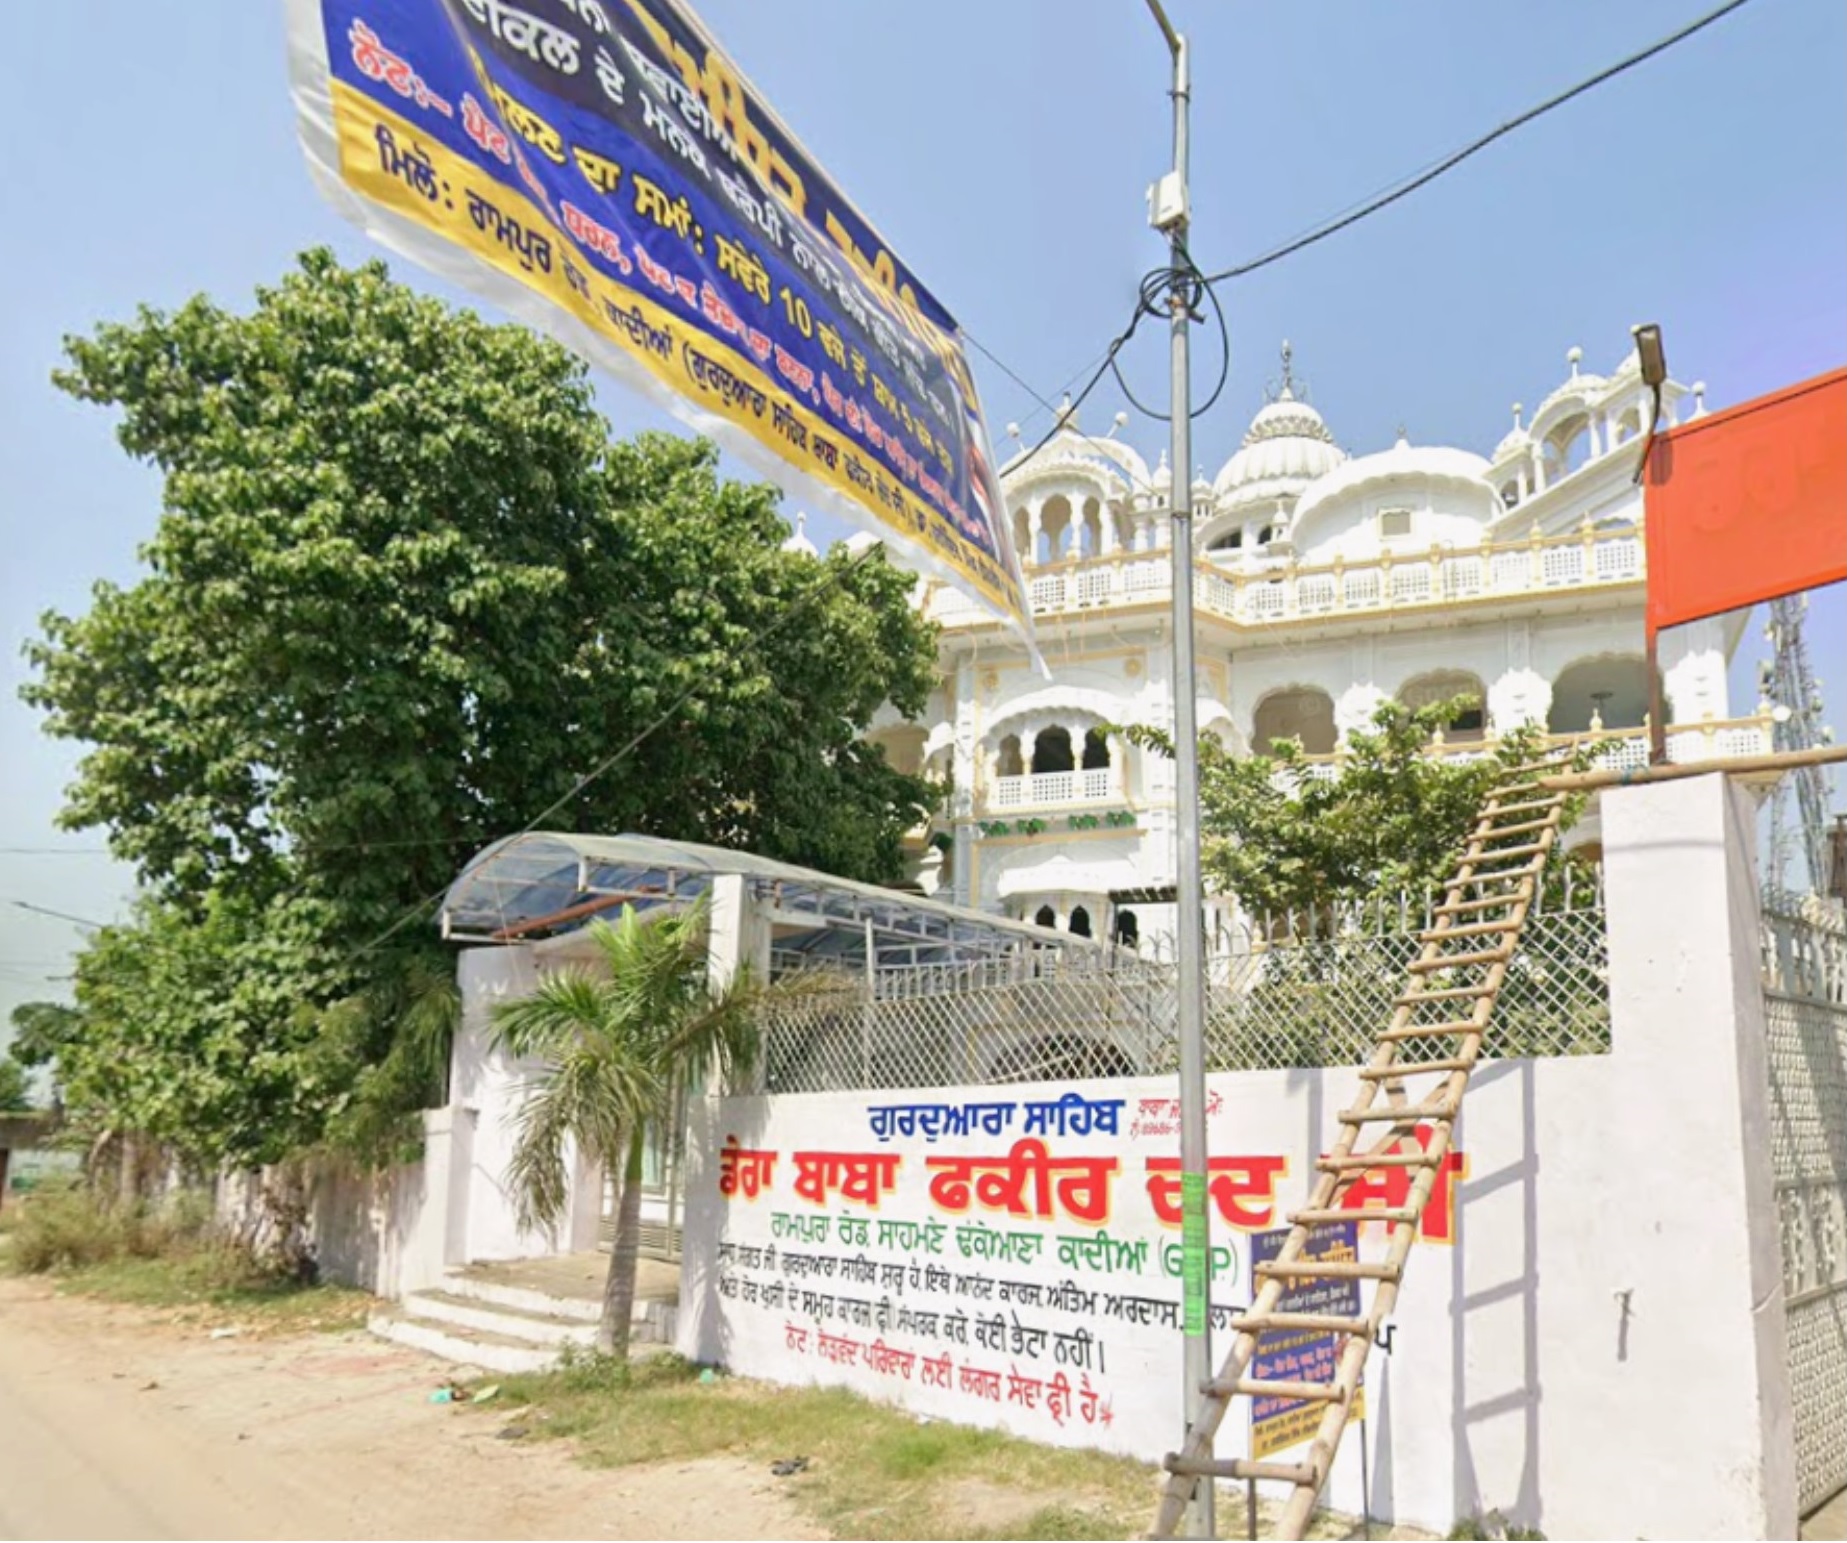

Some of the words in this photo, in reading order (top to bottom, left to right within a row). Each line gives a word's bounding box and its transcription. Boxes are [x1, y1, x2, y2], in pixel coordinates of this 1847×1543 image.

[594, 46, 626, 105] ਦੇ
[374, 122, 455, 211] ਮਿਲੋ:
[465, 186, 552, 274] ਰਾਮਪੁਰ
[572, 146, 621, 193] ਦਾ
[780, 288, 812, 338] 10
[867, 1101, 1018, 1143] ਗੁਰਦੁਆਰਾ
[1024, 1092, 1126, 1137] ਸਾਹਿਬ
[719, 1133, 779, 1200] ਡੇਰਾ
[792, 1151, 902, 1208] ਬਾਬਾ
[924, 1136, 1122, 1224] ਫਕੀਰ
[840, 1253, 878, 1285] ਸਾਹਿਬ
[1056, 1229, 1149, 1276] ਕਾਦੀਆਂ
